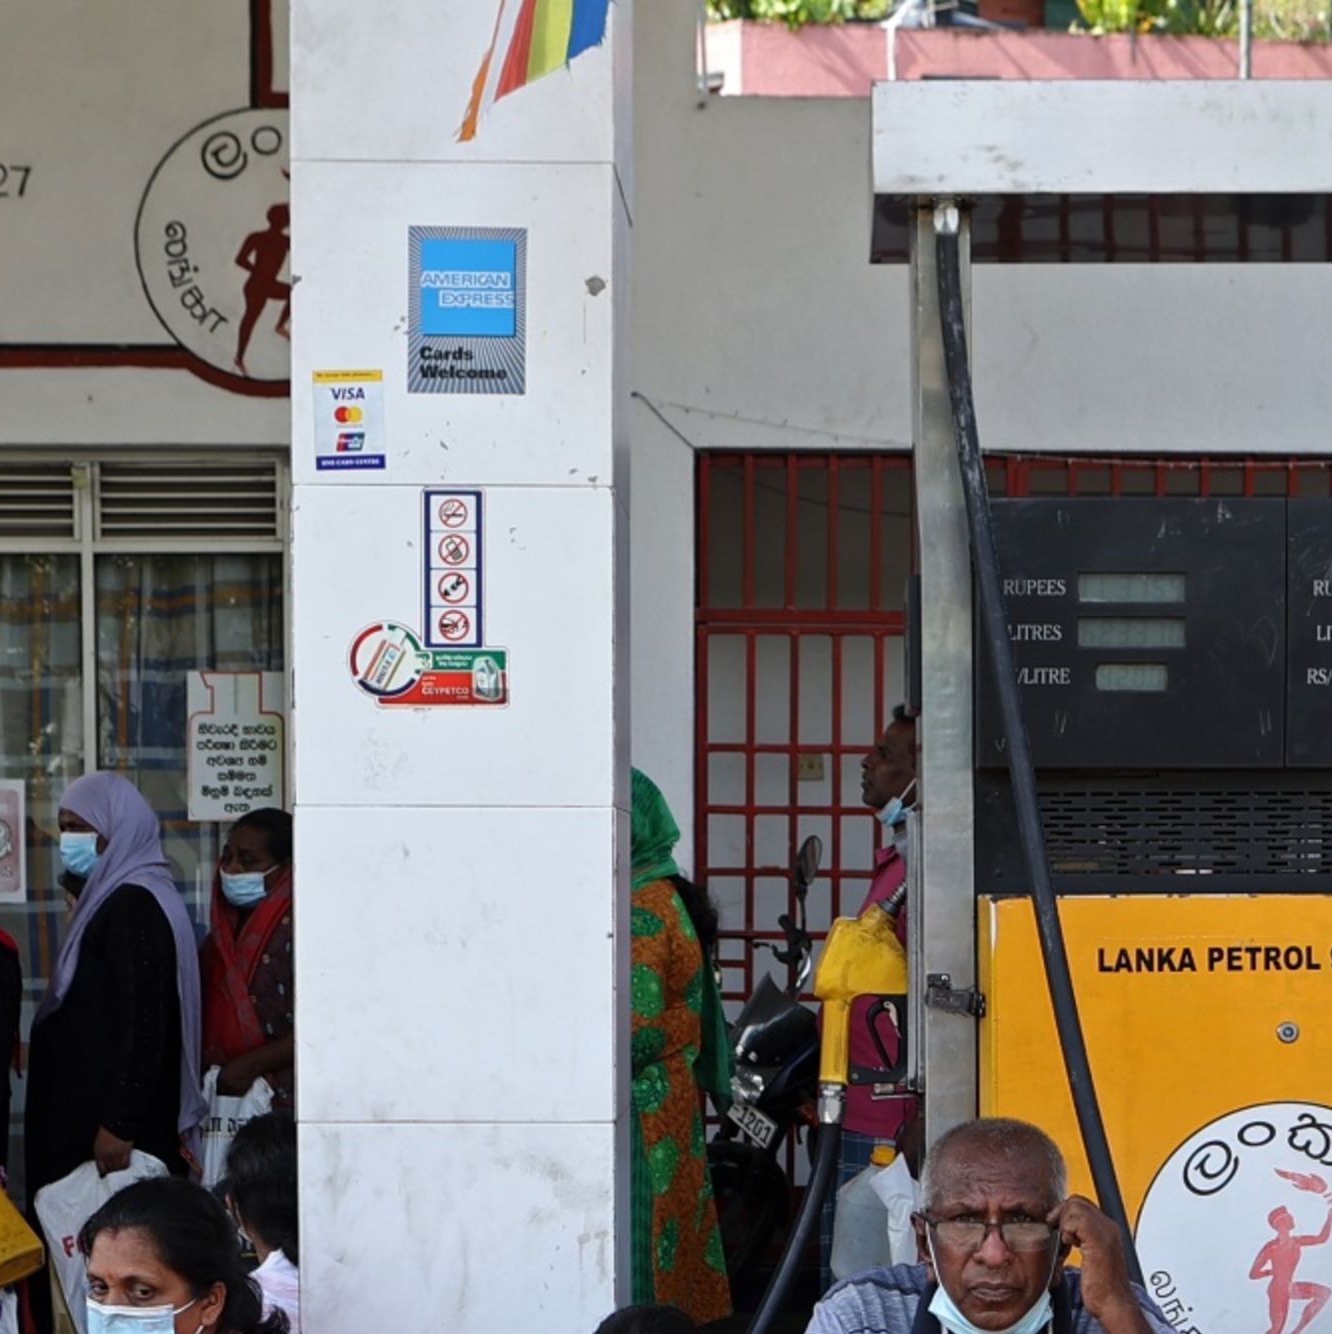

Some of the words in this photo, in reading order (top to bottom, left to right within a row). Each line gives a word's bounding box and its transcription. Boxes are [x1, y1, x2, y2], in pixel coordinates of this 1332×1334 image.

[421, 271, 511, 289] AMERICAN
[419, 346, 474, 361] Cards
[419, 364, 508, 380] Welcome
[331, 387, 365, 400] VISA
[1003, 579, 1067, 597] RUPEES
[1097, 947, 1197, 973] LANKA
[1207, 946, 1321, 972] PETROL
